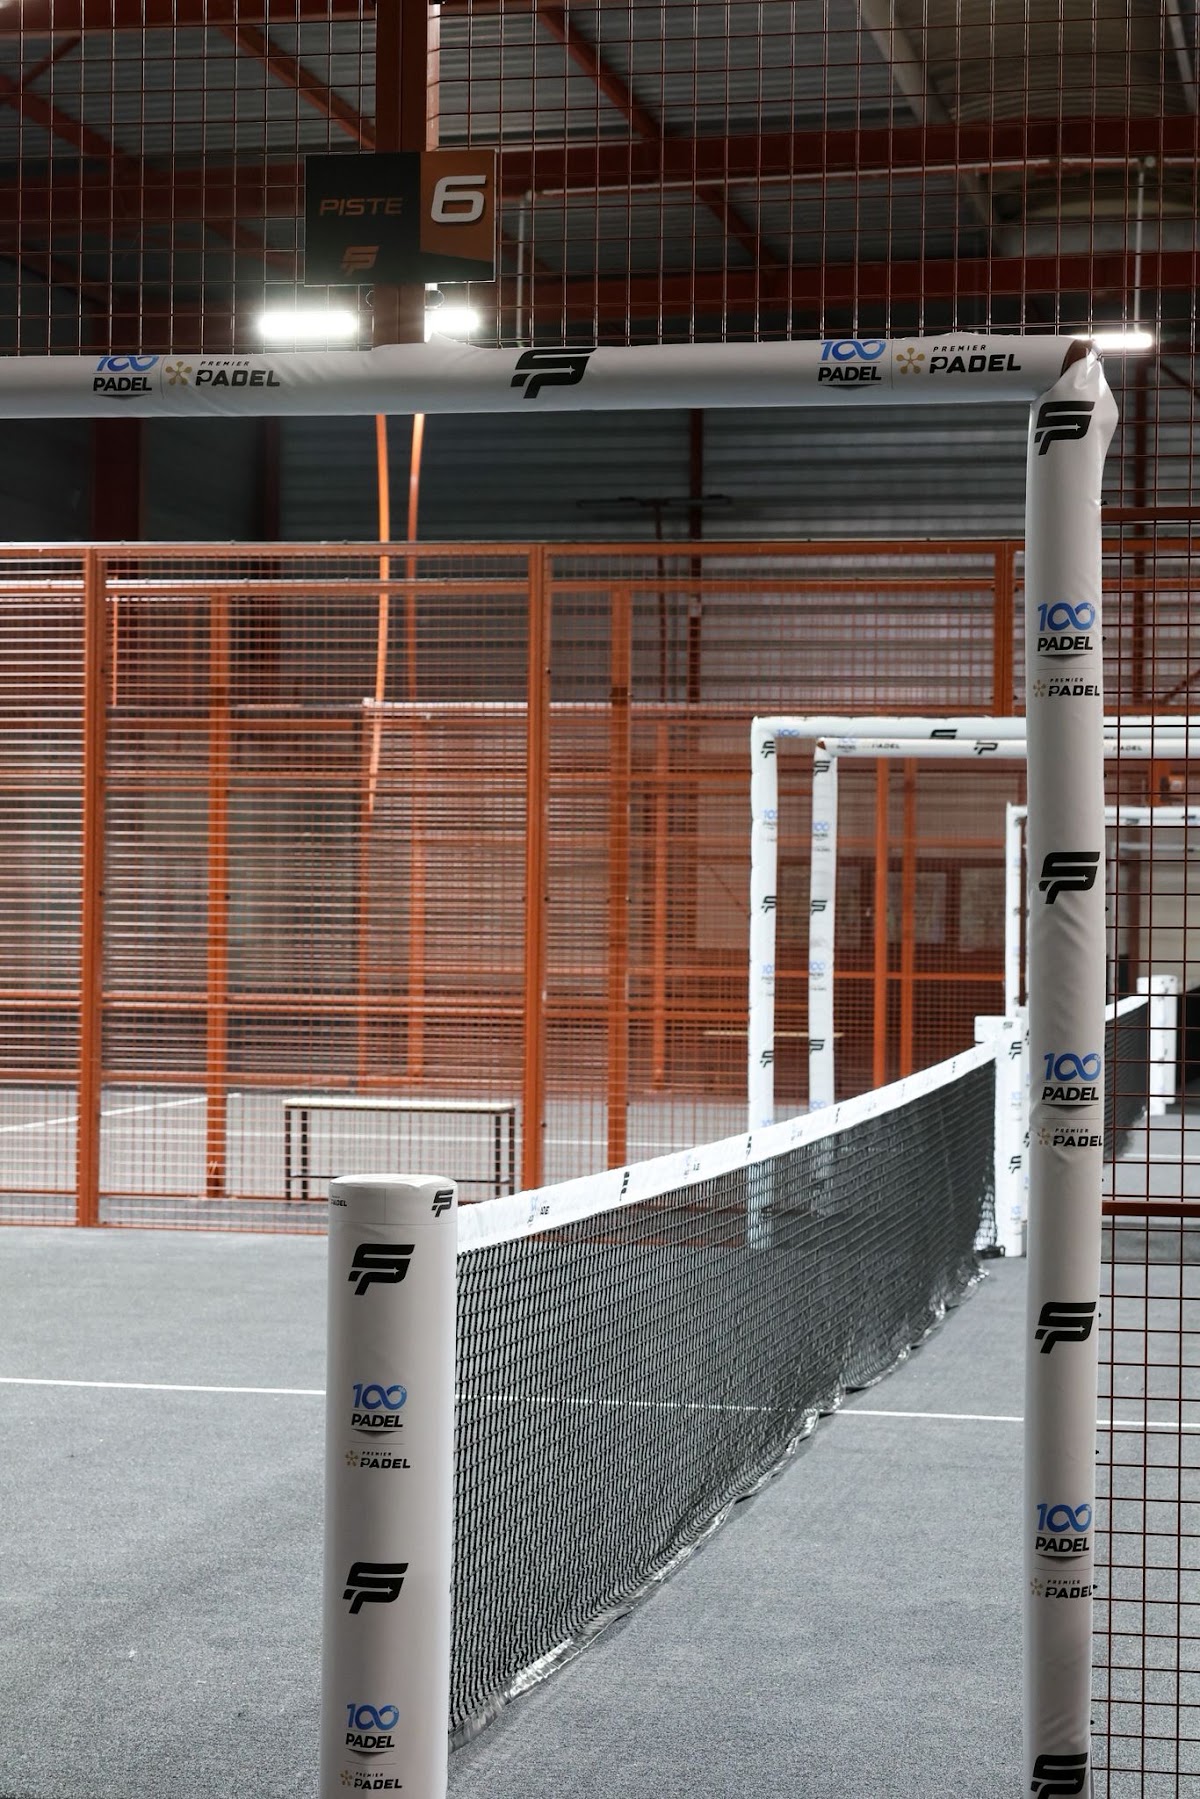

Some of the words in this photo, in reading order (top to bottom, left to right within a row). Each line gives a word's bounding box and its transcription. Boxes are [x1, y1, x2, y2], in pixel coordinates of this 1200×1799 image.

[319, 198, 404, 216] PISTE
[431, 175, 487, 222] 6
[933, 344, 987, 352] PREMIER
[930, 354, 1022, 374] PADEL
[195, 370, 280, 387] PADEL
[818, 366, 882, 382] PADEL
[93, 377, 152, 391] PADEL
[1037, 602, 1096, 631] 100
[1037, 636, 1093, 651] PADEL
[1048, 685, 1100, 697] PADEL
[1044, 1053, 1101, 1081] 100
[1042, 1086, 1099, 1101] PADEL
[353, 1383, 407, 1410] 100
[351, 1413, 403, 1428] PADEL
[360, 1457, 411, 1469] PADEL
[1037, 1503, 1092, 1532] 100
[1035, 1536, 1090, 1552] PADEL
[347, 1703, 400, 1730] 100
[345, 1733, 395, 1749] PADEL
[354, 1778, 403, 1790] PADEL
